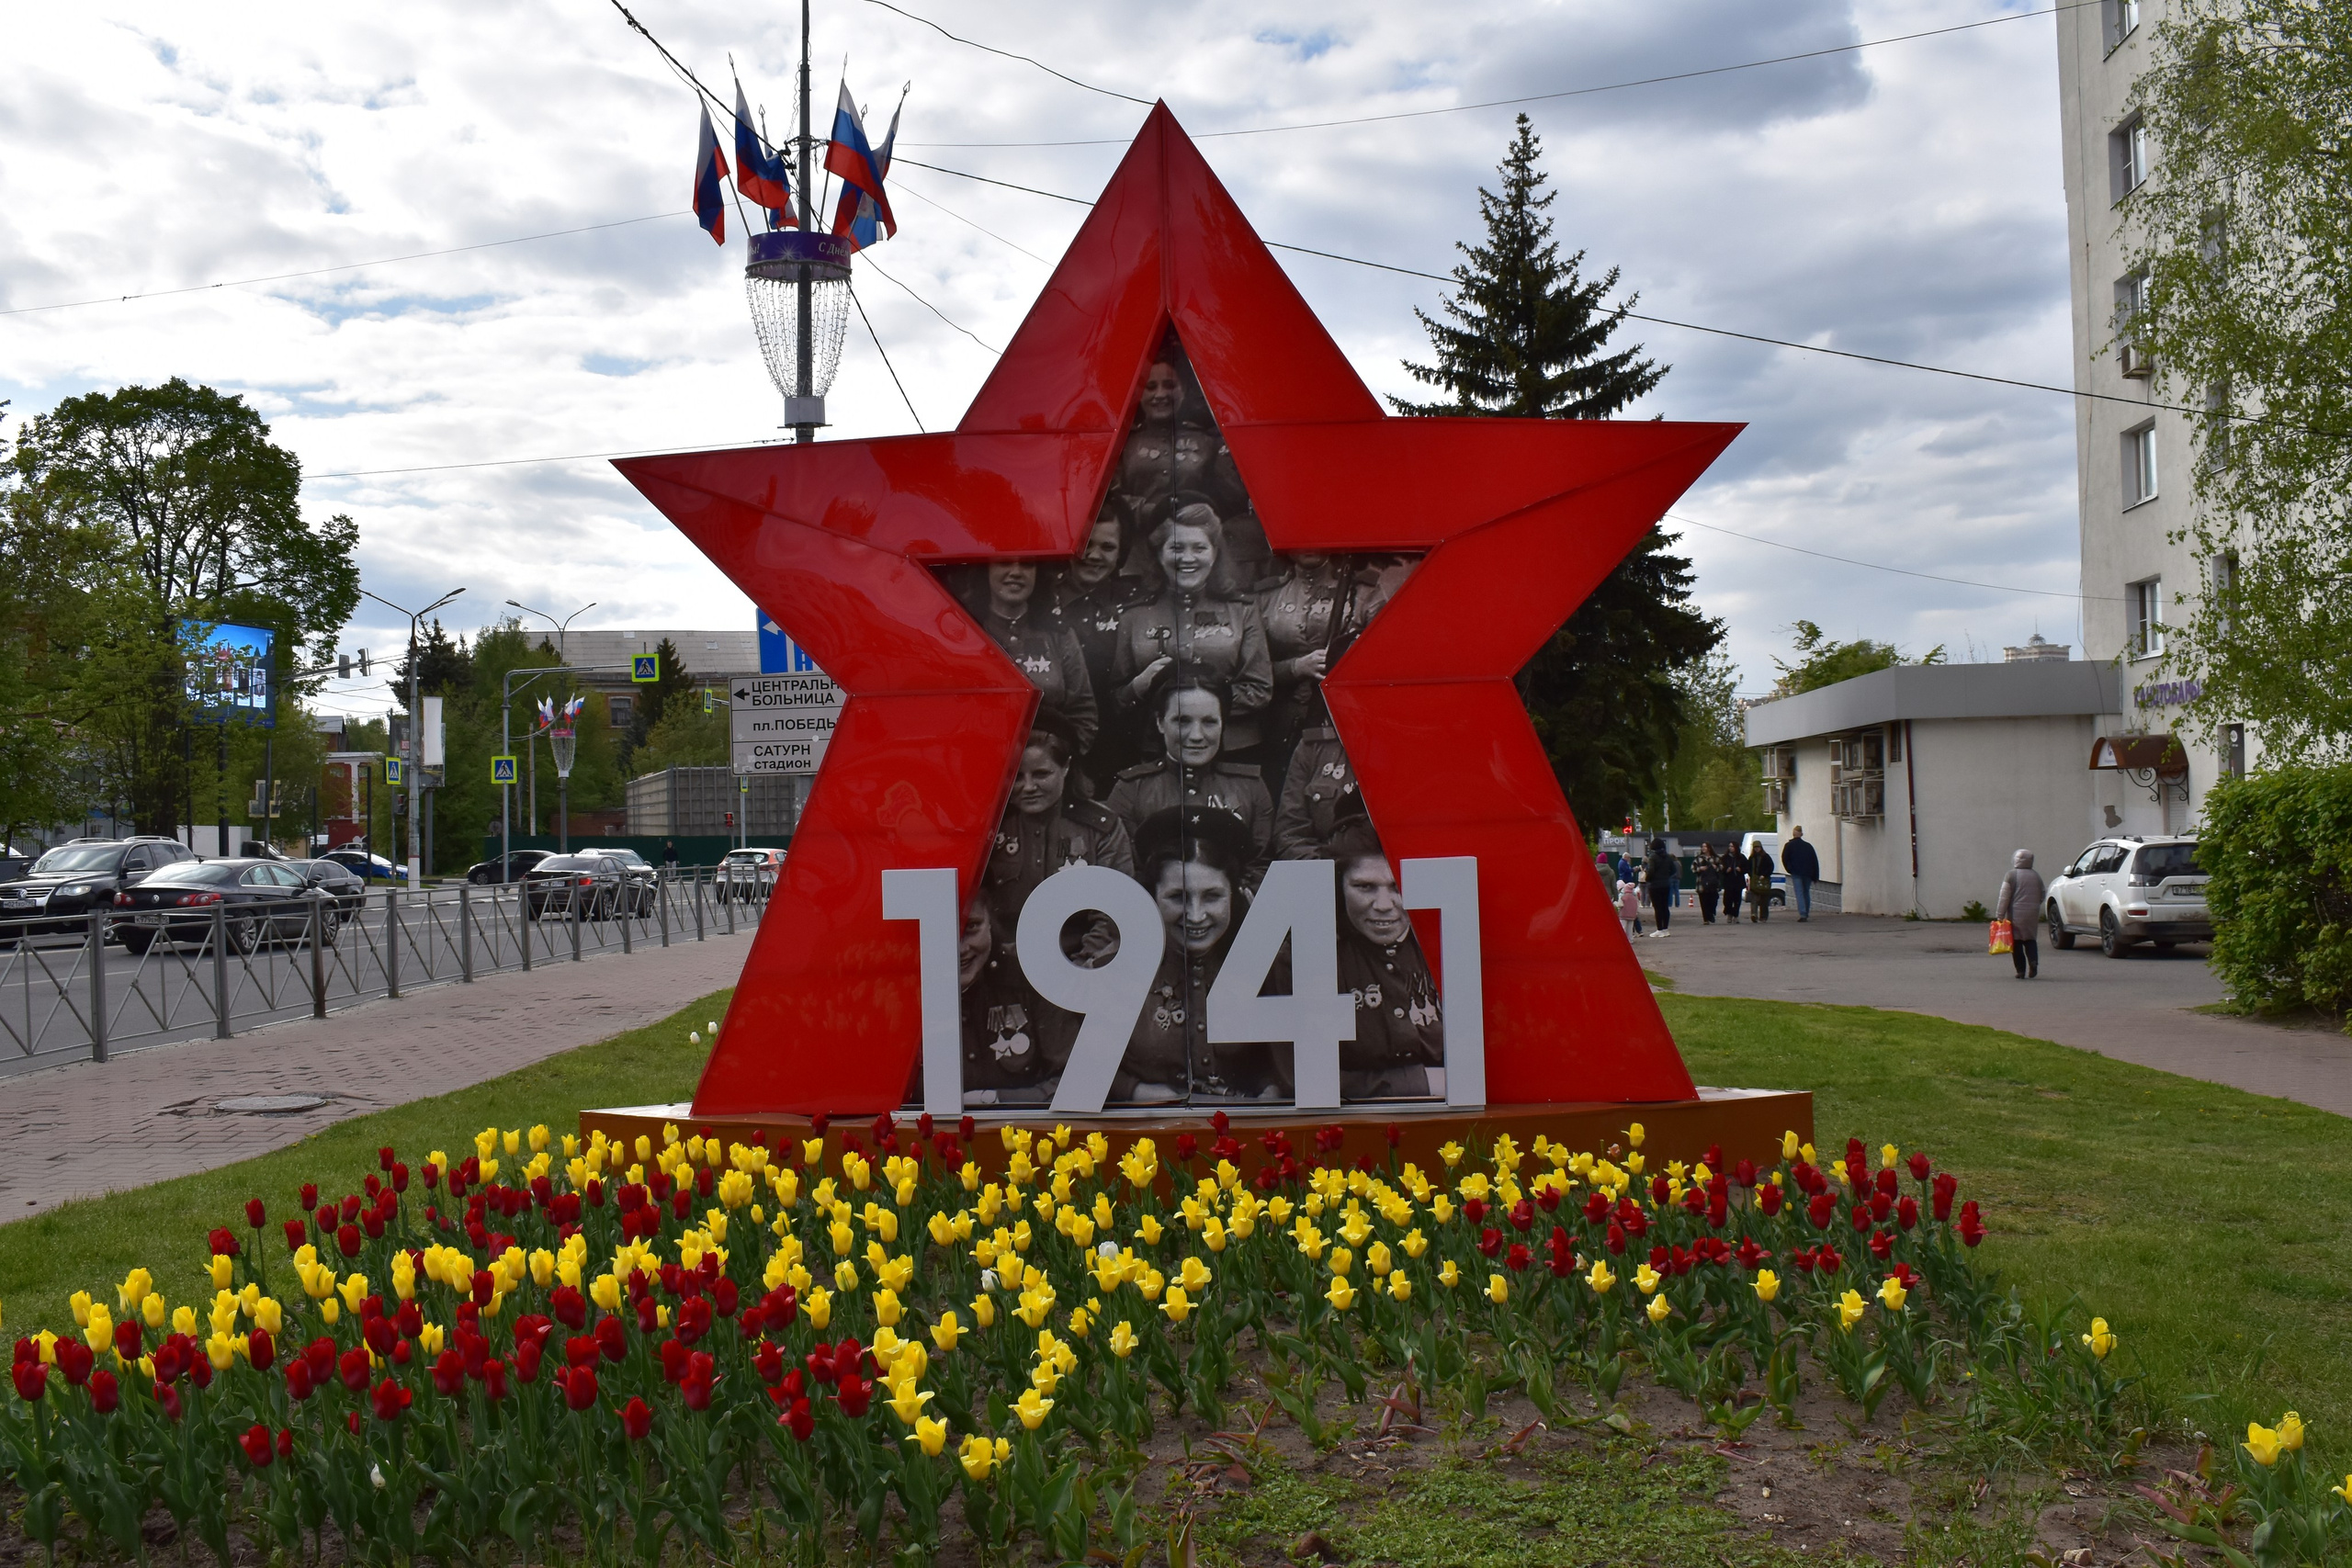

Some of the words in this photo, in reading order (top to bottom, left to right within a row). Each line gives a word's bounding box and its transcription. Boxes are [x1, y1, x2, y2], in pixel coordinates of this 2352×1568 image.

[752, 679, 840, 693] ЦЕНТРАЛЬН
[752, 693, 835, 706] БОЛЬНИЦА
[753, 744, 810, 757] САТУРН
[753, 760, 811, 771] стадион
[882, 856, 1487, 1113] 1941
